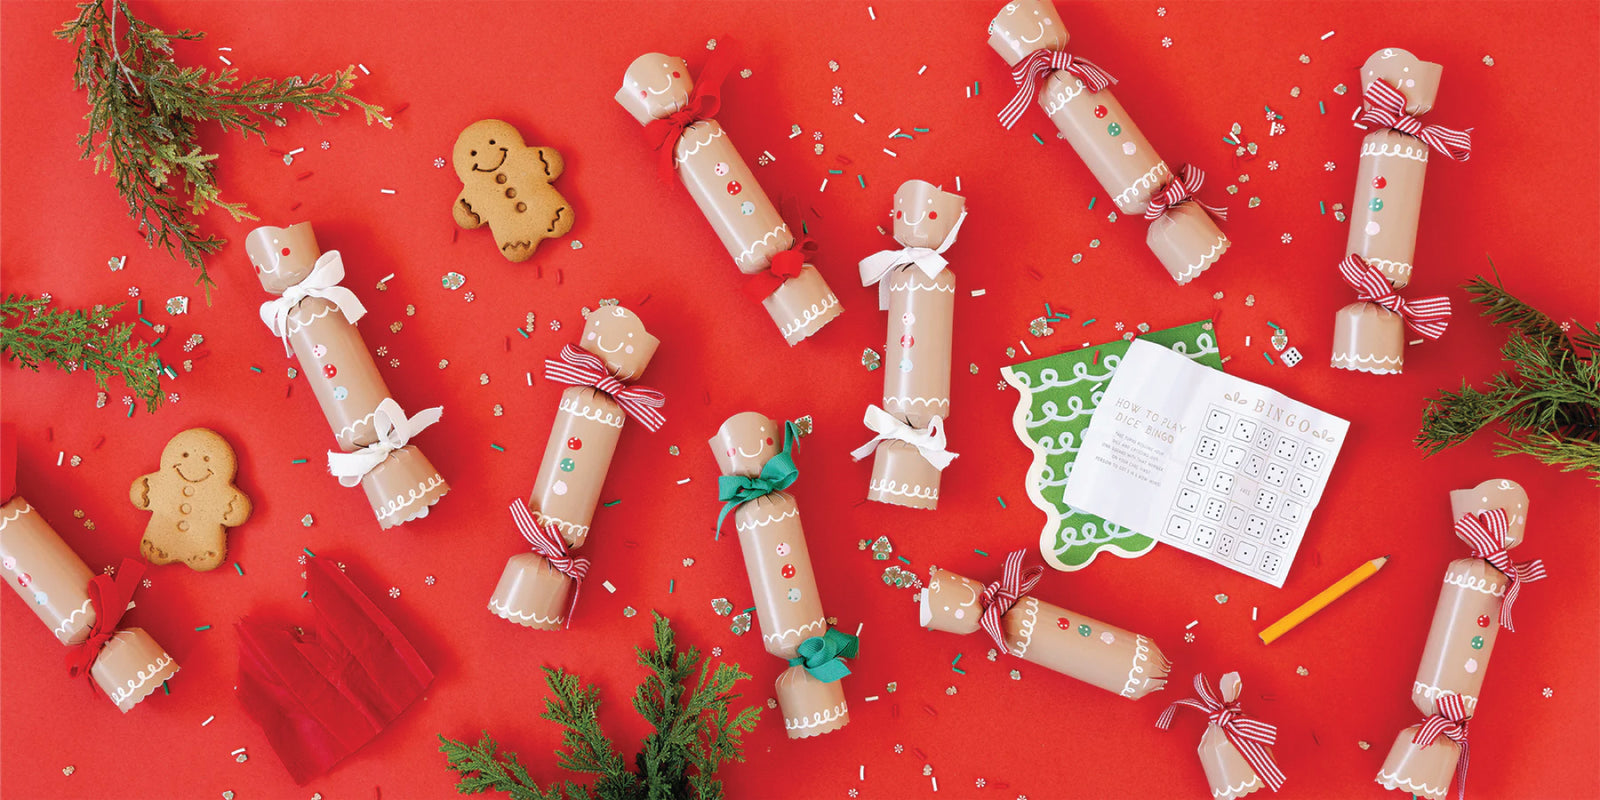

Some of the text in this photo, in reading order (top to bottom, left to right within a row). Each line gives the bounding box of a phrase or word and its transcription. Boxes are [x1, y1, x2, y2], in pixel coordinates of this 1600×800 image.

[1115, 397, 1187, 433] HOW TO PLAY
[1115, 411, 1142, 429] DICE
[1145, 424, 1174, 444] BINGO
[1254, 399, 1311, 433] BINGO
